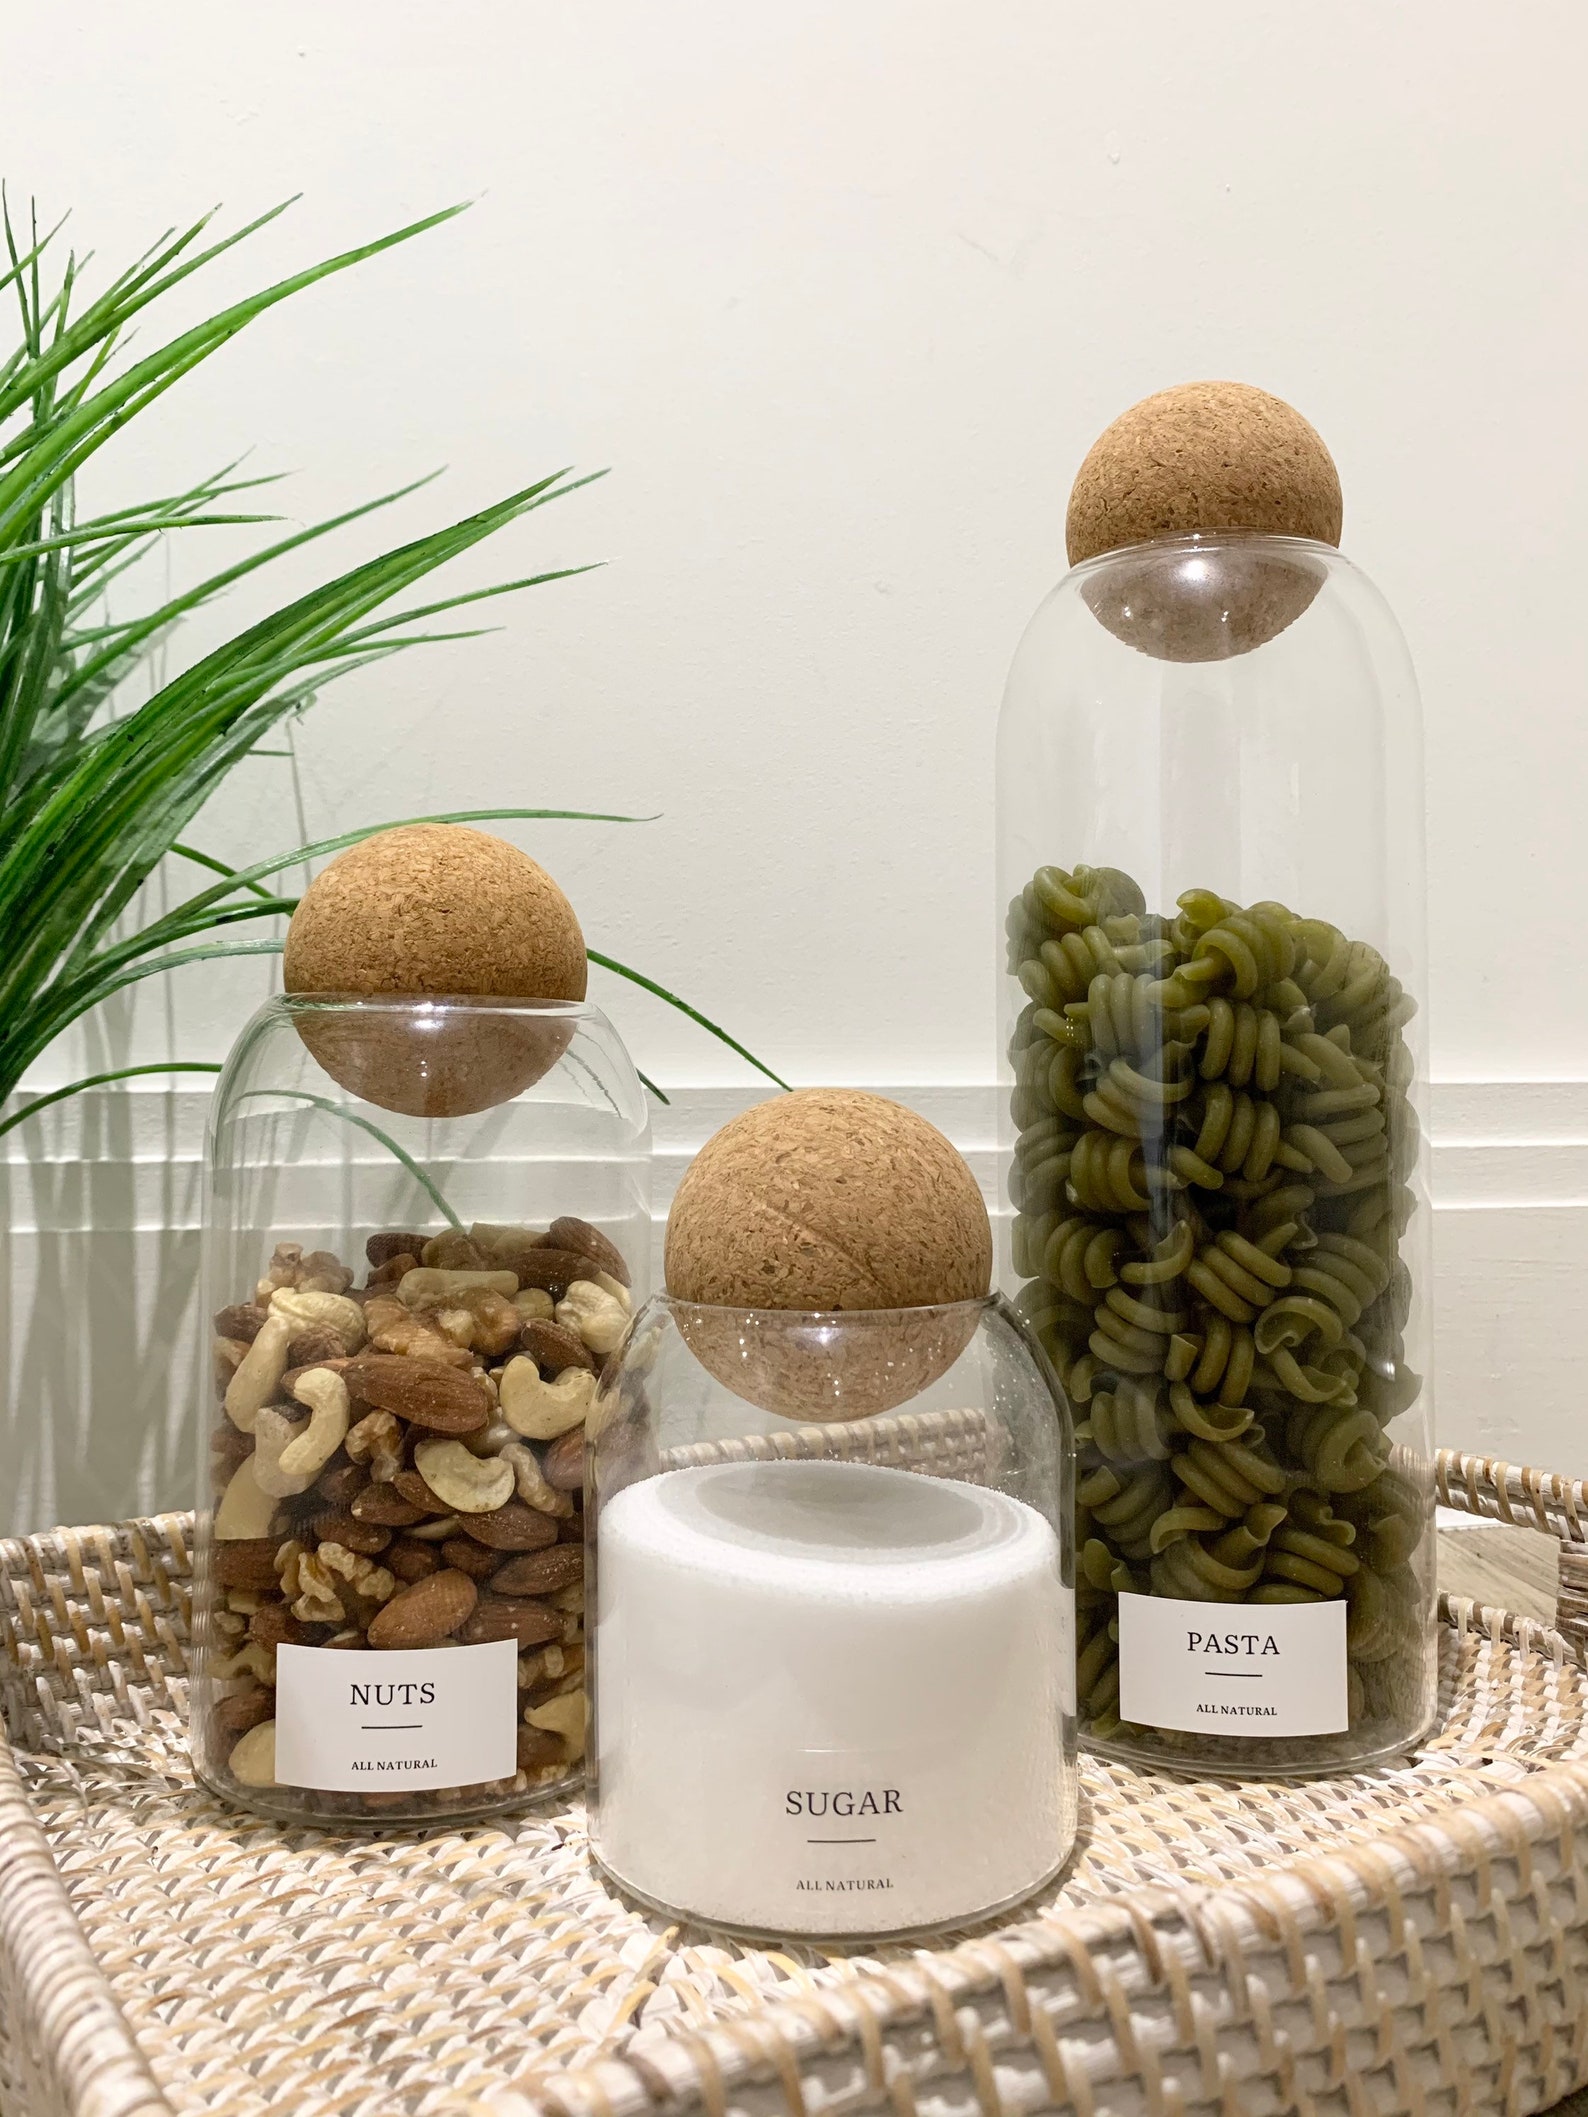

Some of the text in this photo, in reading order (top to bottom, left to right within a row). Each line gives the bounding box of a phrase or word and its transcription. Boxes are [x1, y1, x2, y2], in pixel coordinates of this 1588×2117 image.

[1187, 1631, 1281, 1656] PASTA
[349, 1682, 436, 1706] NUTS
[1195, 1703, 1278, 1716] ALL NATURAL
[351, 1758, 438, 1771] ALL NATURAL
[785, 1789, 904, 1817] SUGAR
[796, 1877, 894, 1891] ALL NATURAL
